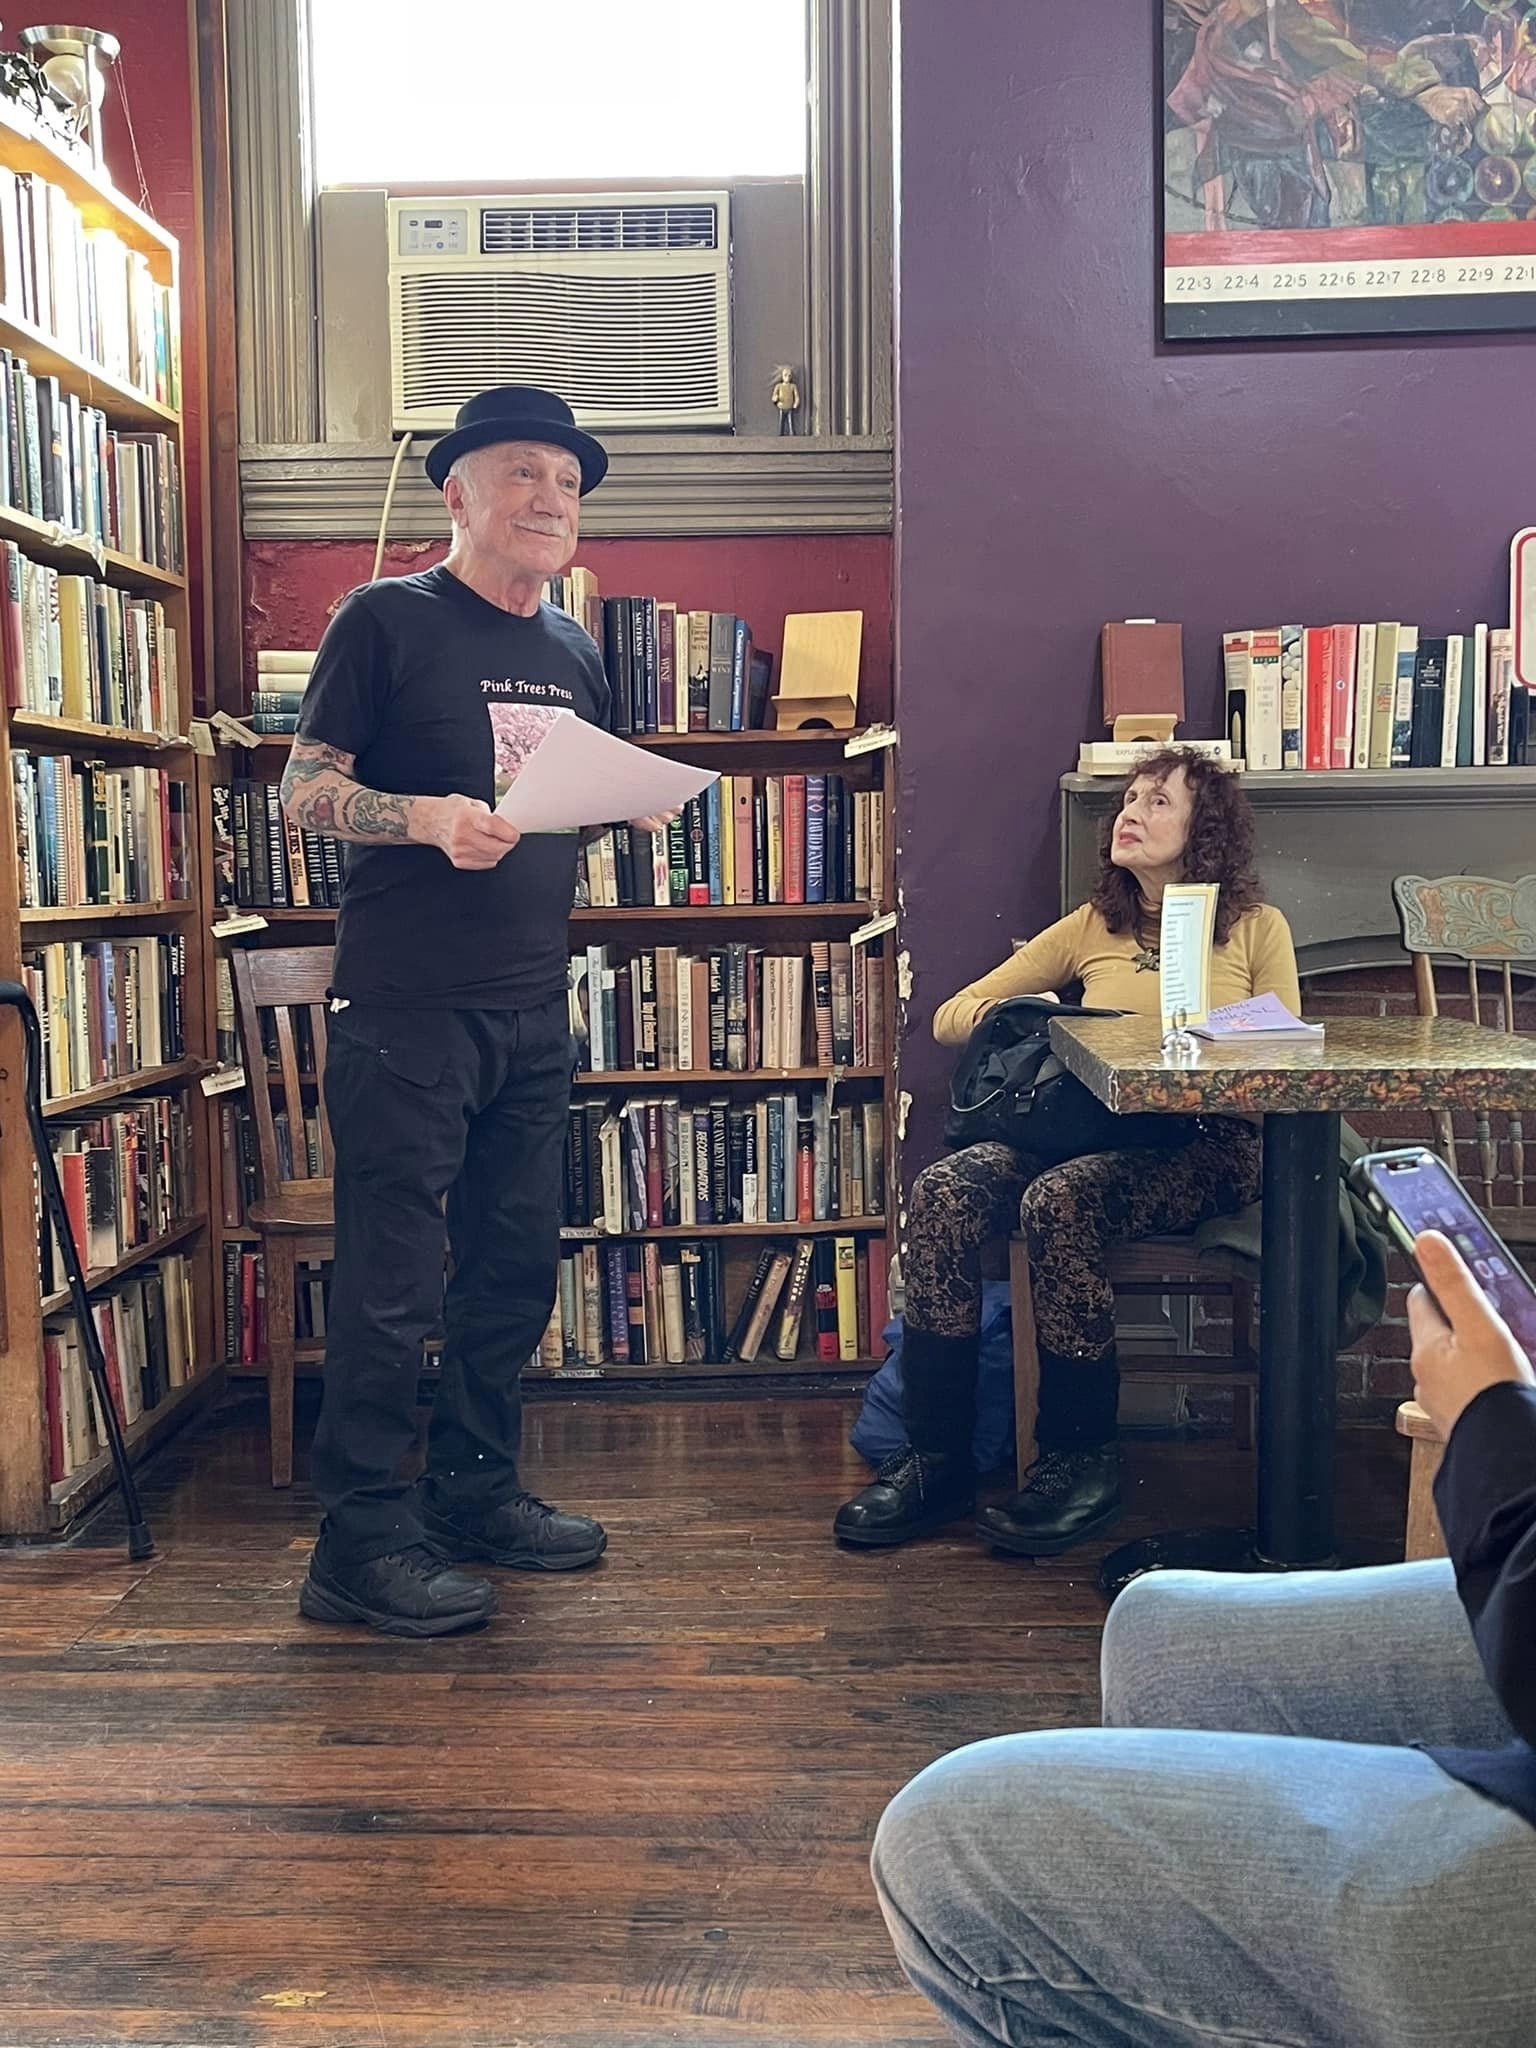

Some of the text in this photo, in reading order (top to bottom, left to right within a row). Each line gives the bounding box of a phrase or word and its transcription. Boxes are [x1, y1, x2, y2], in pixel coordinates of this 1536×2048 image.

[480, 679, 573, 700] Pink Trees Press
[807, 776, 824, 813] SIRO
[289, 834, 301, 855] DIES
[670, 829, 686, 865] LIGHT
[808, 817, 823, 888] DAVID IGNATIUS
[696, 1130, 709, 1202] RECOMBINATIONS
[789, 1243, 809, 1302] PARADISE
